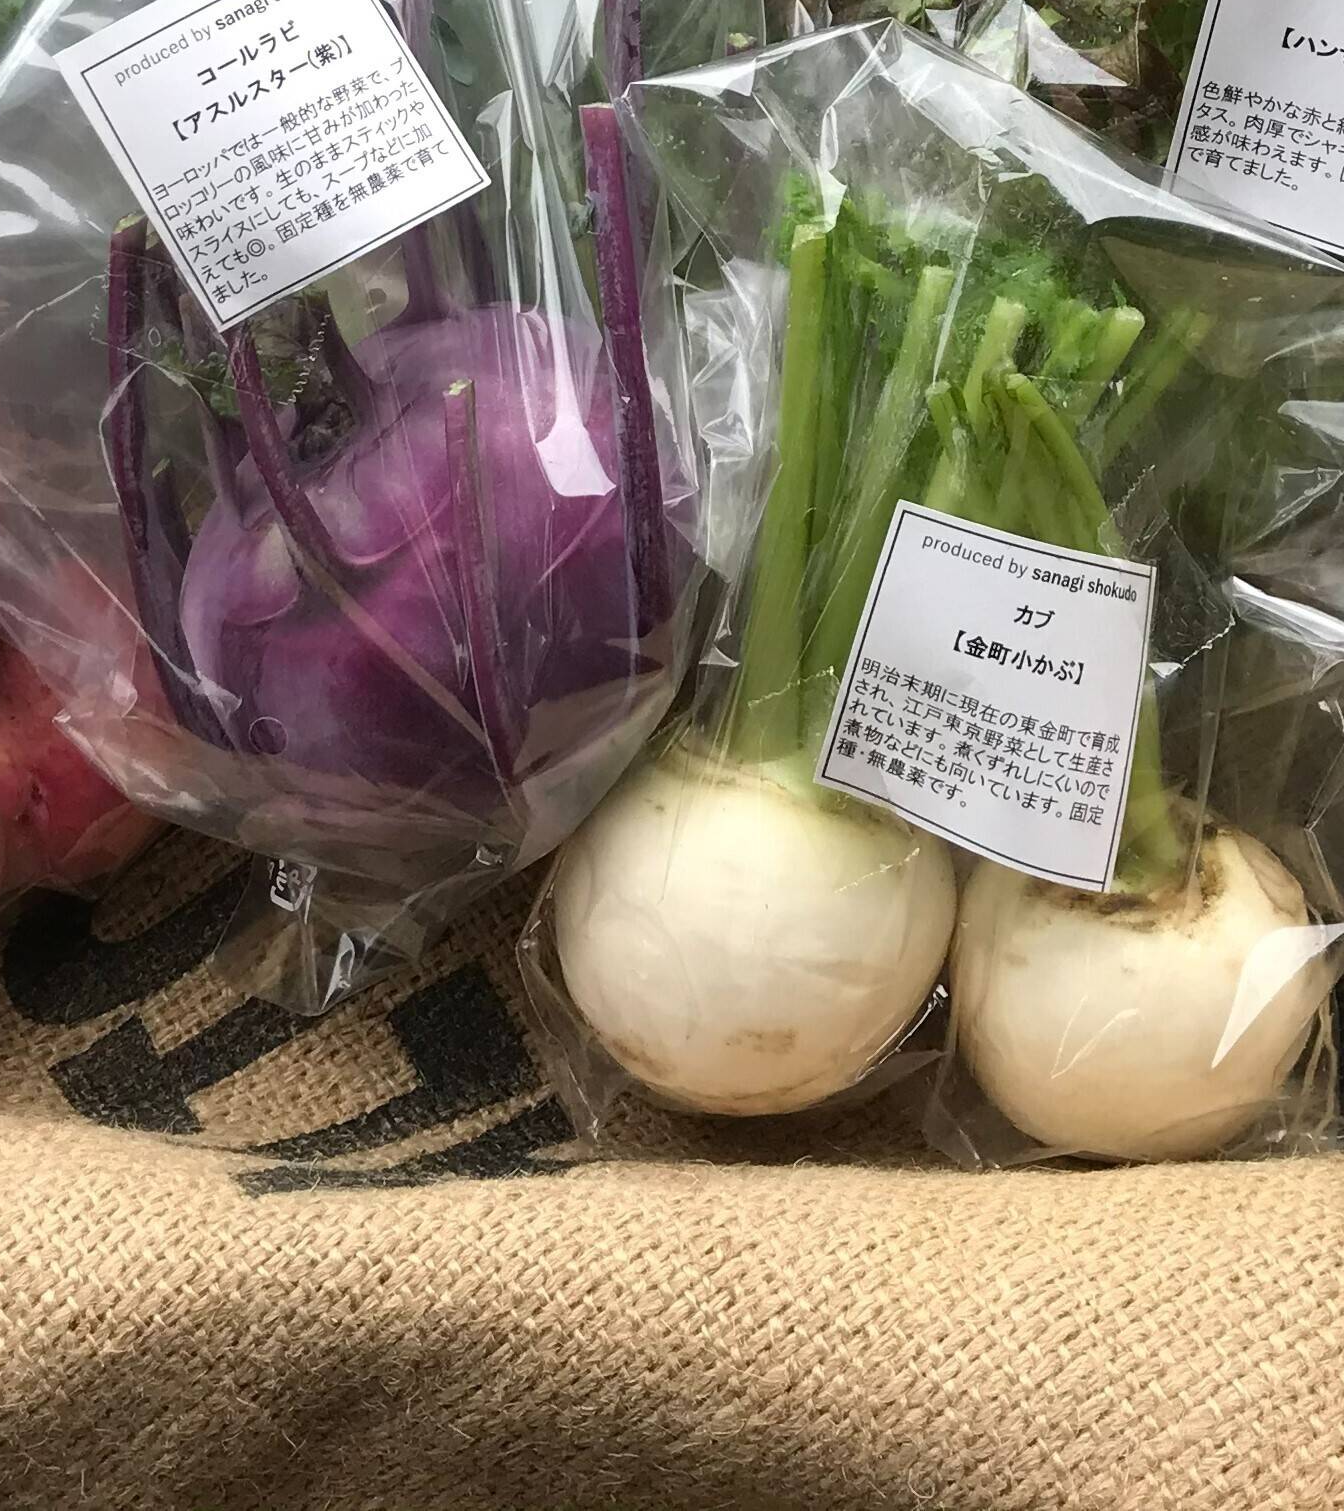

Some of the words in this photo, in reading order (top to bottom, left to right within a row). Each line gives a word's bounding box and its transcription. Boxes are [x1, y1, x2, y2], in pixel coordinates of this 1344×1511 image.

[113, 33, 189, 87] produced
[189, 24, 211, 42] by
[196, 19, 300, 86] コールラビ
[1184, 142, 1298, 191] で育てました。
[208, 270, 268, 305] ました。
[921, 535, 1005, 570] produced
[1007, 556, 1029, 579] by
[1030, 567, 1085, 593] sanagi
[1086, 577, 1137, 602] shokudo
[1012, 604, 1056, 629] カブ
[952, 628, 1085, 686] 【金町小かぶ】
